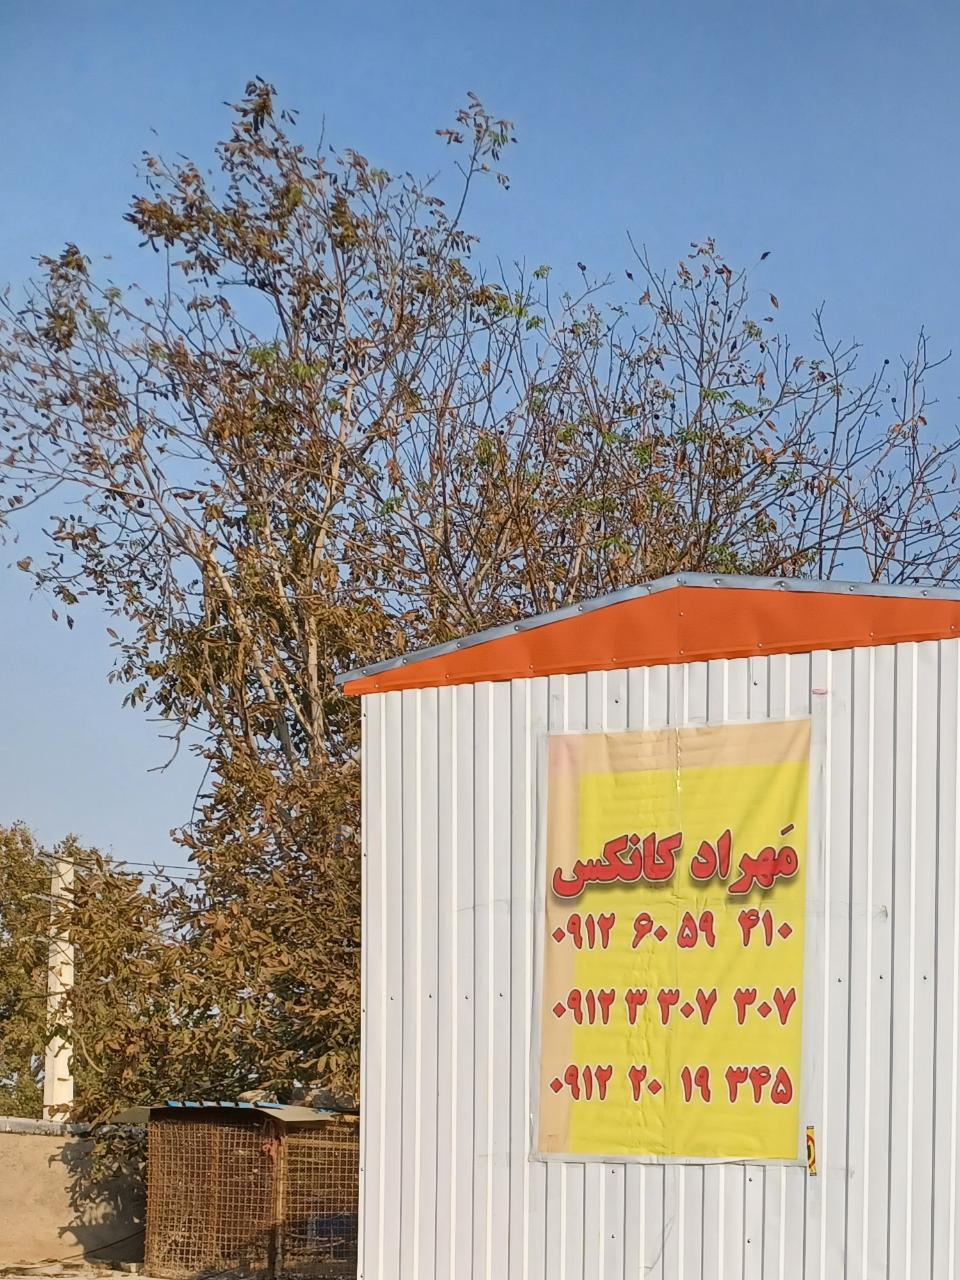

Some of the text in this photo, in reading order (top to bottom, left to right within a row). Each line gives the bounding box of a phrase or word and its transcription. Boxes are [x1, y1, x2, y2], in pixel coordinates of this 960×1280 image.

[552, 831, 683, 897] کانکس
[551, 908, 793, 950] ۰۹۱۲ ۶۰ ۵۹ ۴۱۰
[552, 988, 616, 1025] ۰۹۱۲
[733, 987, 797, 1025] ۳۰۷
[549, 1064, 793, 1104] ۰۹۱۲ ۲۰ ۱۹ ۳۴۵
